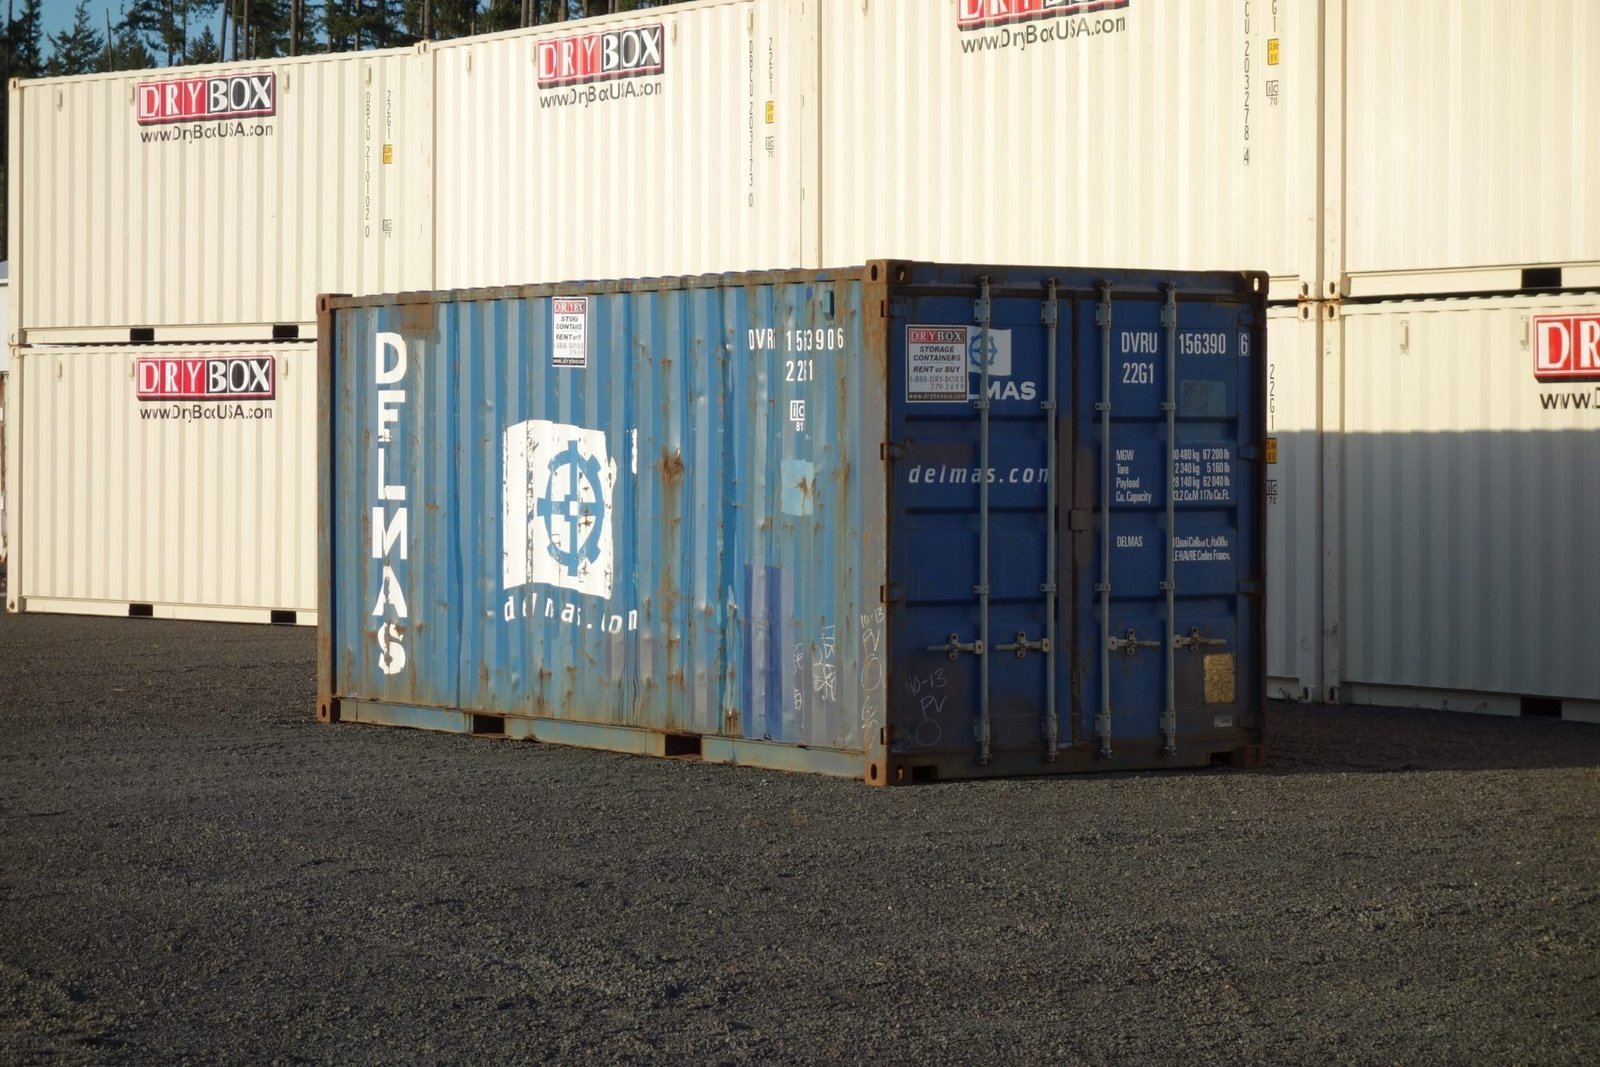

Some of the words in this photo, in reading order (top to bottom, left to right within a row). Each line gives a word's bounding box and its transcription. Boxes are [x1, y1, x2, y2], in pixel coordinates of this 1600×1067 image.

[910, 330, 963, 342] DRYBOX
[920, 345, 955, 353] STORAGE
[1121, 332, 1158, 353] DVRU
[1179, 333, 1226, 355] 156390
[1240, 334, 1249, 355] 6
[913, 354, 961, 362] CONTAINERS
[913, 365, 934, 373] RENT
[944, 365, 961, 373] BUY
[1122, 362, 1154, 384] 22G1
[1116, 449, 1134, 460] MGW
[1192, 448, 1200, 462] kg
[1202, 448, 1211, 460] 67
[1117, 463, 1129, 475] Tare
[1192, 462, 1200, 476] kg
[1116, 477, 1139, 490] Payload
[1192, 476, 1200, 489] kg
[1126, 490, 1152, 504] Capacity
[1116, 536, 1143, 547] DELMAS
